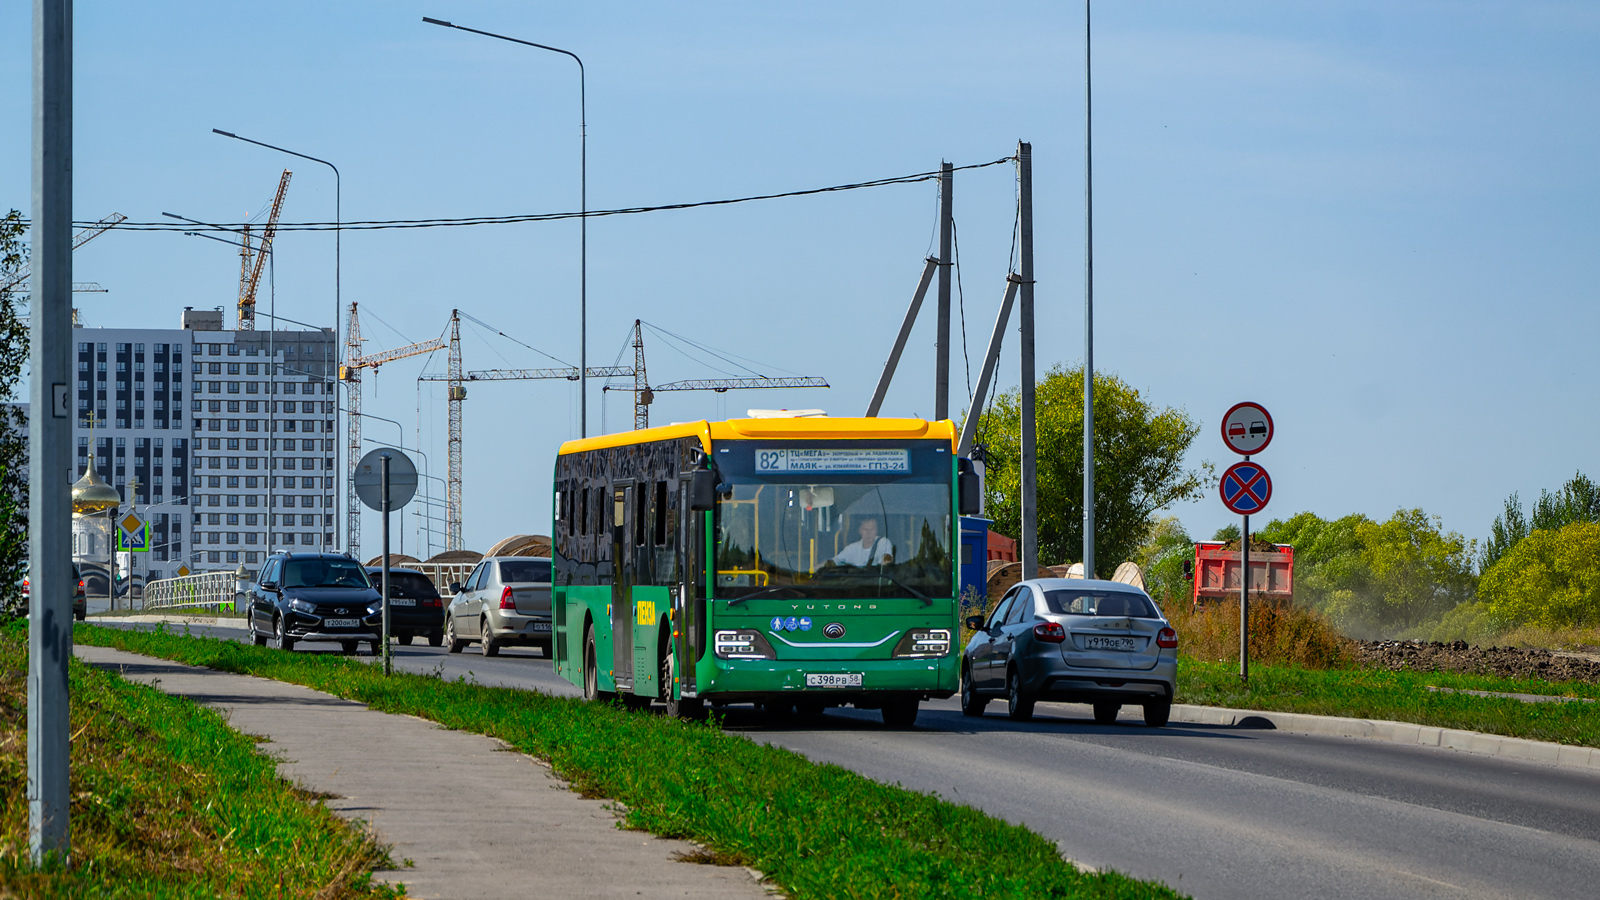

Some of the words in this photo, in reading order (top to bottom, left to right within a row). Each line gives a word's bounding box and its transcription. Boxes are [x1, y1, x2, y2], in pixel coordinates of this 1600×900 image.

[868, 462, 904, 470] ГПЗ-24
[637, 600, 656, 626] ПЕНЗА
[1121, 638, 1134, 646] 790
[849, 674, 859, 682] 58
